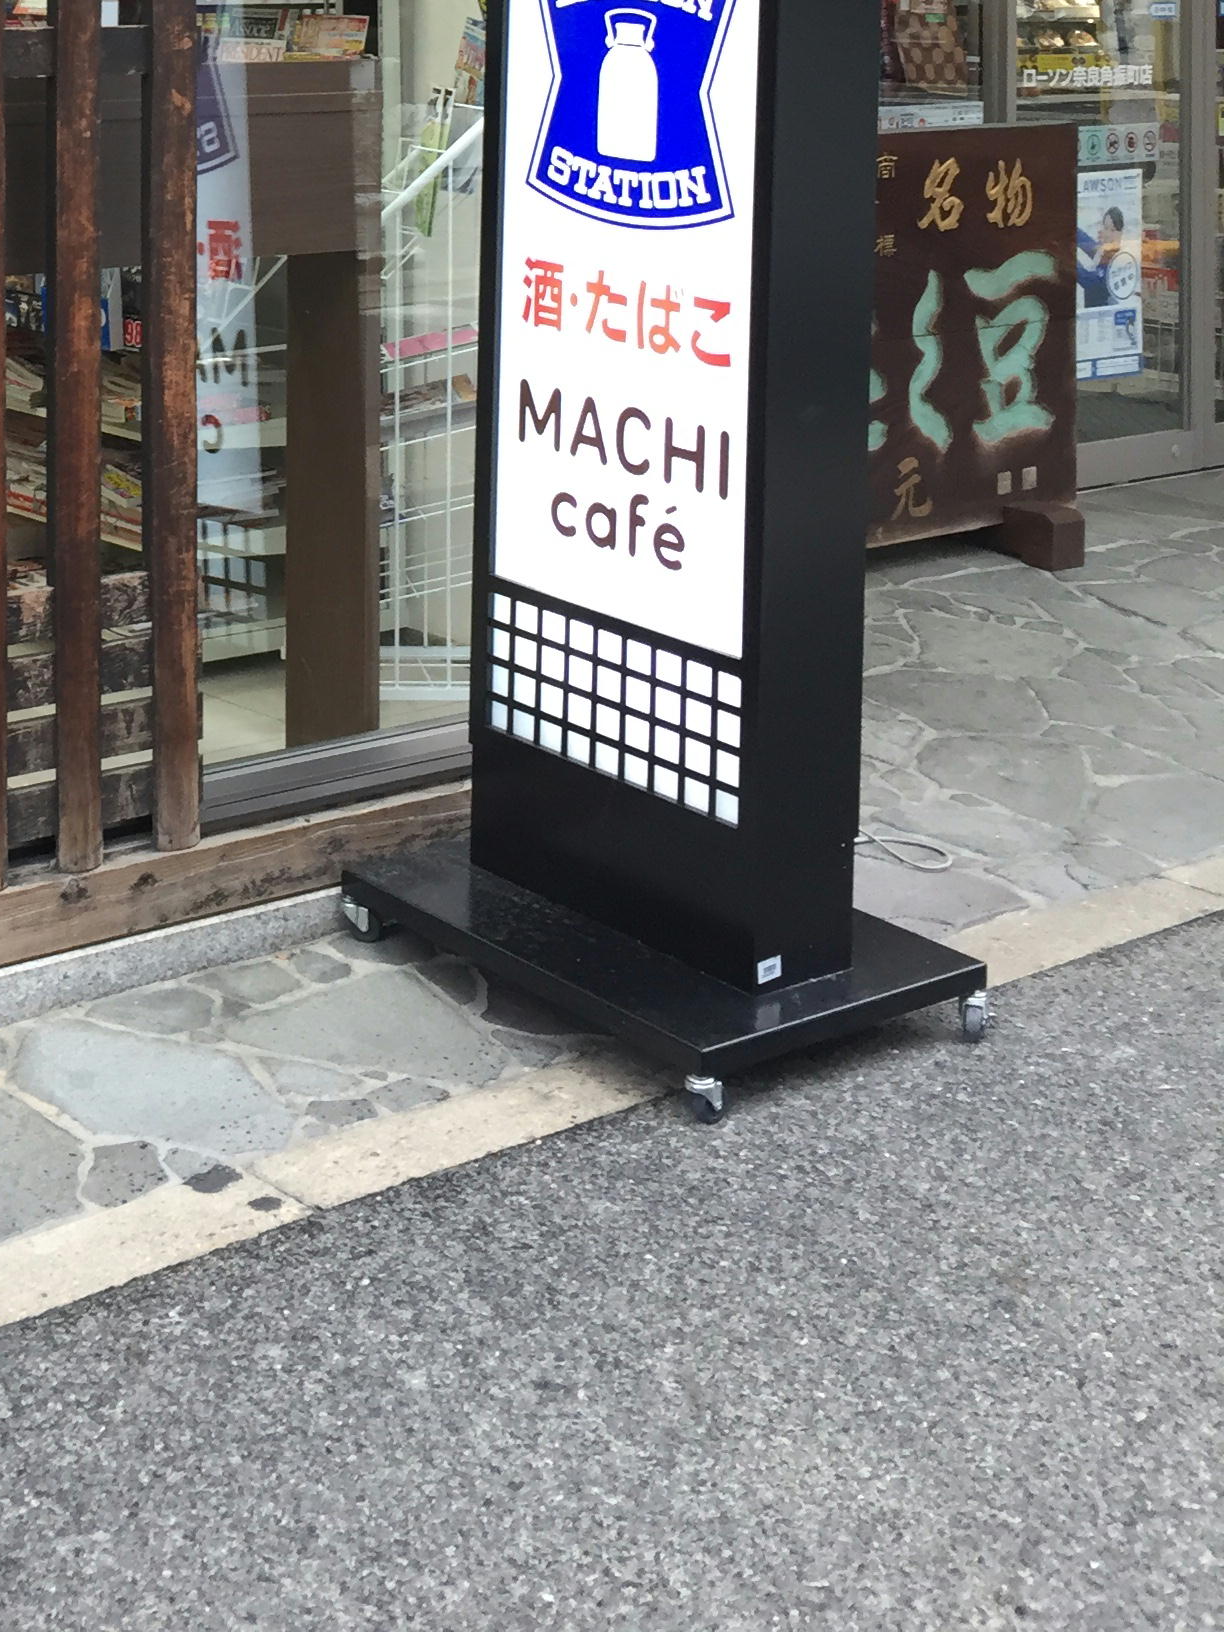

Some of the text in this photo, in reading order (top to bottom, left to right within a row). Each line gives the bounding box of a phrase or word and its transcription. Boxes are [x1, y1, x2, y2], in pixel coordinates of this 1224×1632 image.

[547, 145, 712, 210] STATION
[1079, 176, 1122, 193] AWSON
[518, 378, 730, 500] MACHI
[550, 491, 685, 571] café
